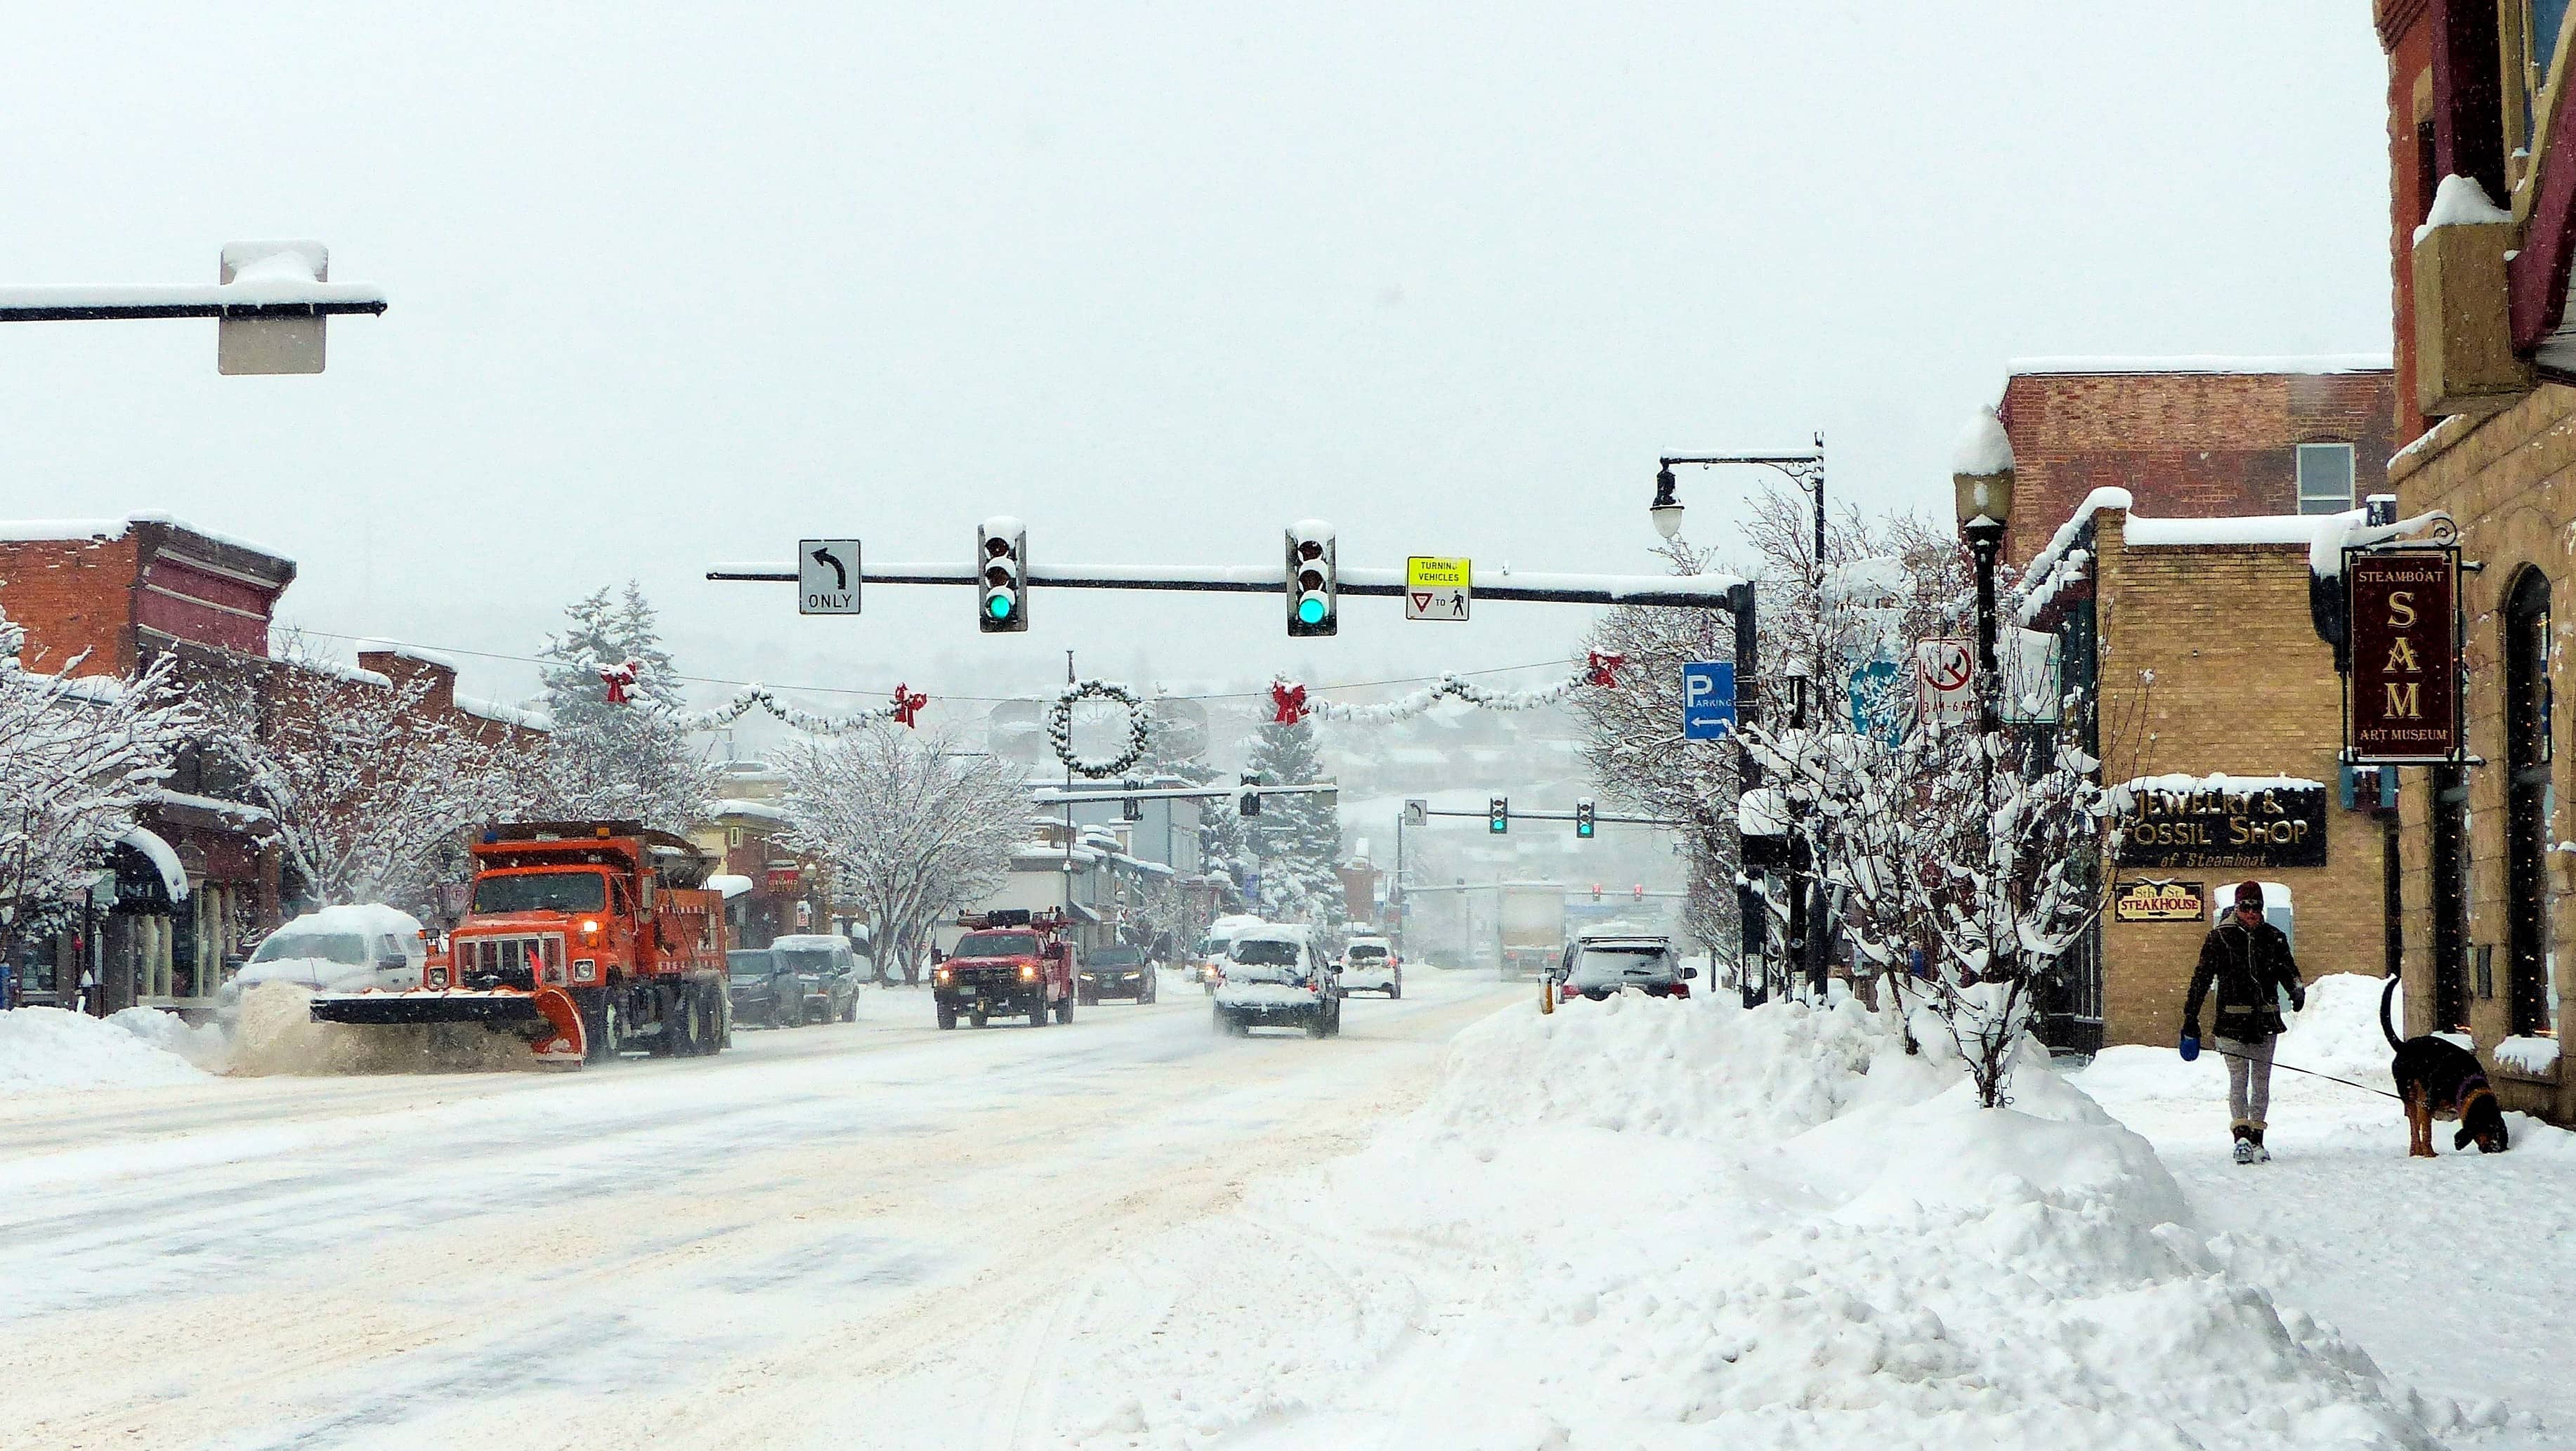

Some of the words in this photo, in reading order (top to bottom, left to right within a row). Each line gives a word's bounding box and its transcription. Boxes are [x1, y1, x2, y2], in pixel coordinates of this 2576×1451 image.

[1418, 572, 1460, 582] VEHICLES
[2358, 570, 2444, 583] STEAMBOAT
[809, 593, 852, 608] ONLY
[1435, 598, 1446, 607] TO
[2360, 728, 2388, 741] ART
[2391, 728, 2448, 742] MUSEUM
[2135, 789, 2250, 823] JEWELRY
[2263, 789, 2284, 815] &
[2229, 815, 2308, 845] SHOP
[2160, 852, 2180, 868] of
[2185, 852, 2268, 868] Steamboat
[2136, 888, 2155, 899] 8th
[2121, 898, 2199, 911] STEAKHOUSE
